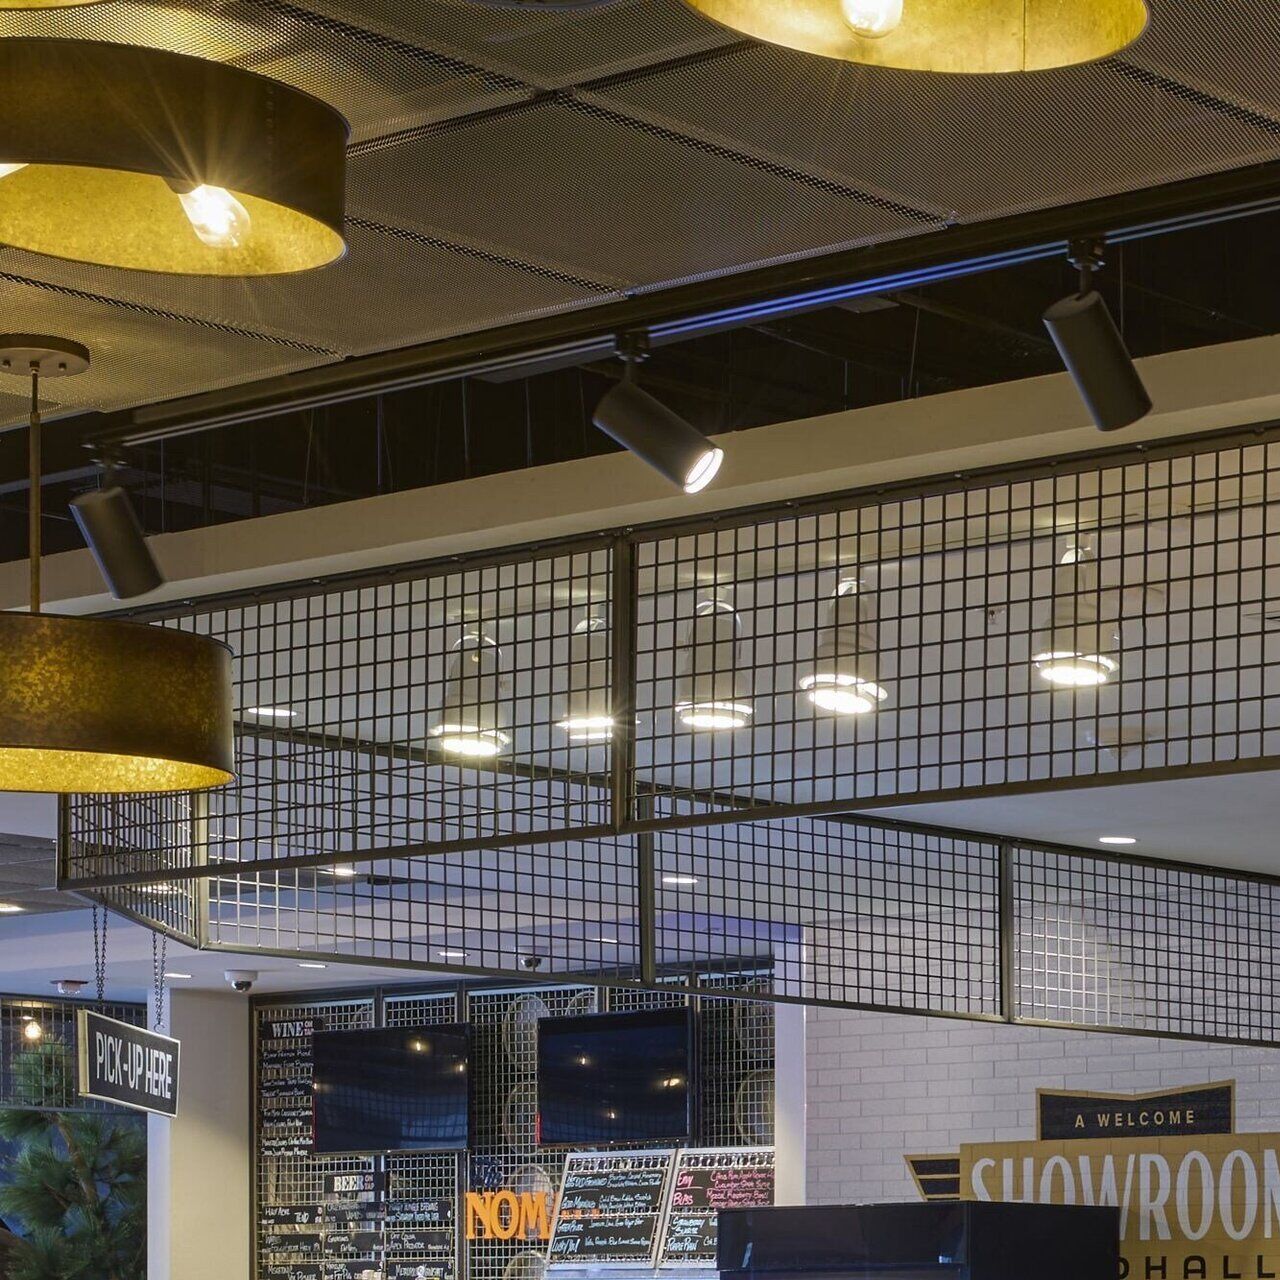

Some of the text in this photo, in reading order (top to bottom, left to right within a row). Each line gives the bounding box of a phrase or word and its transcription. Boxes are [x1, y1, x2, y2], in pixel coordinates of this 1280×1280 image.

[272, 1022, 303, 1038] WINE
[96, 1031, 172, 1099] PICK-UP HERE
[1075, 1110, 1194, 1128] A WELCOME
[333, 1175, 364, 1191] BEER
[466, 1190, 556, 1240] NOM
[1119, 1254, 1276, 1280] DHALL
